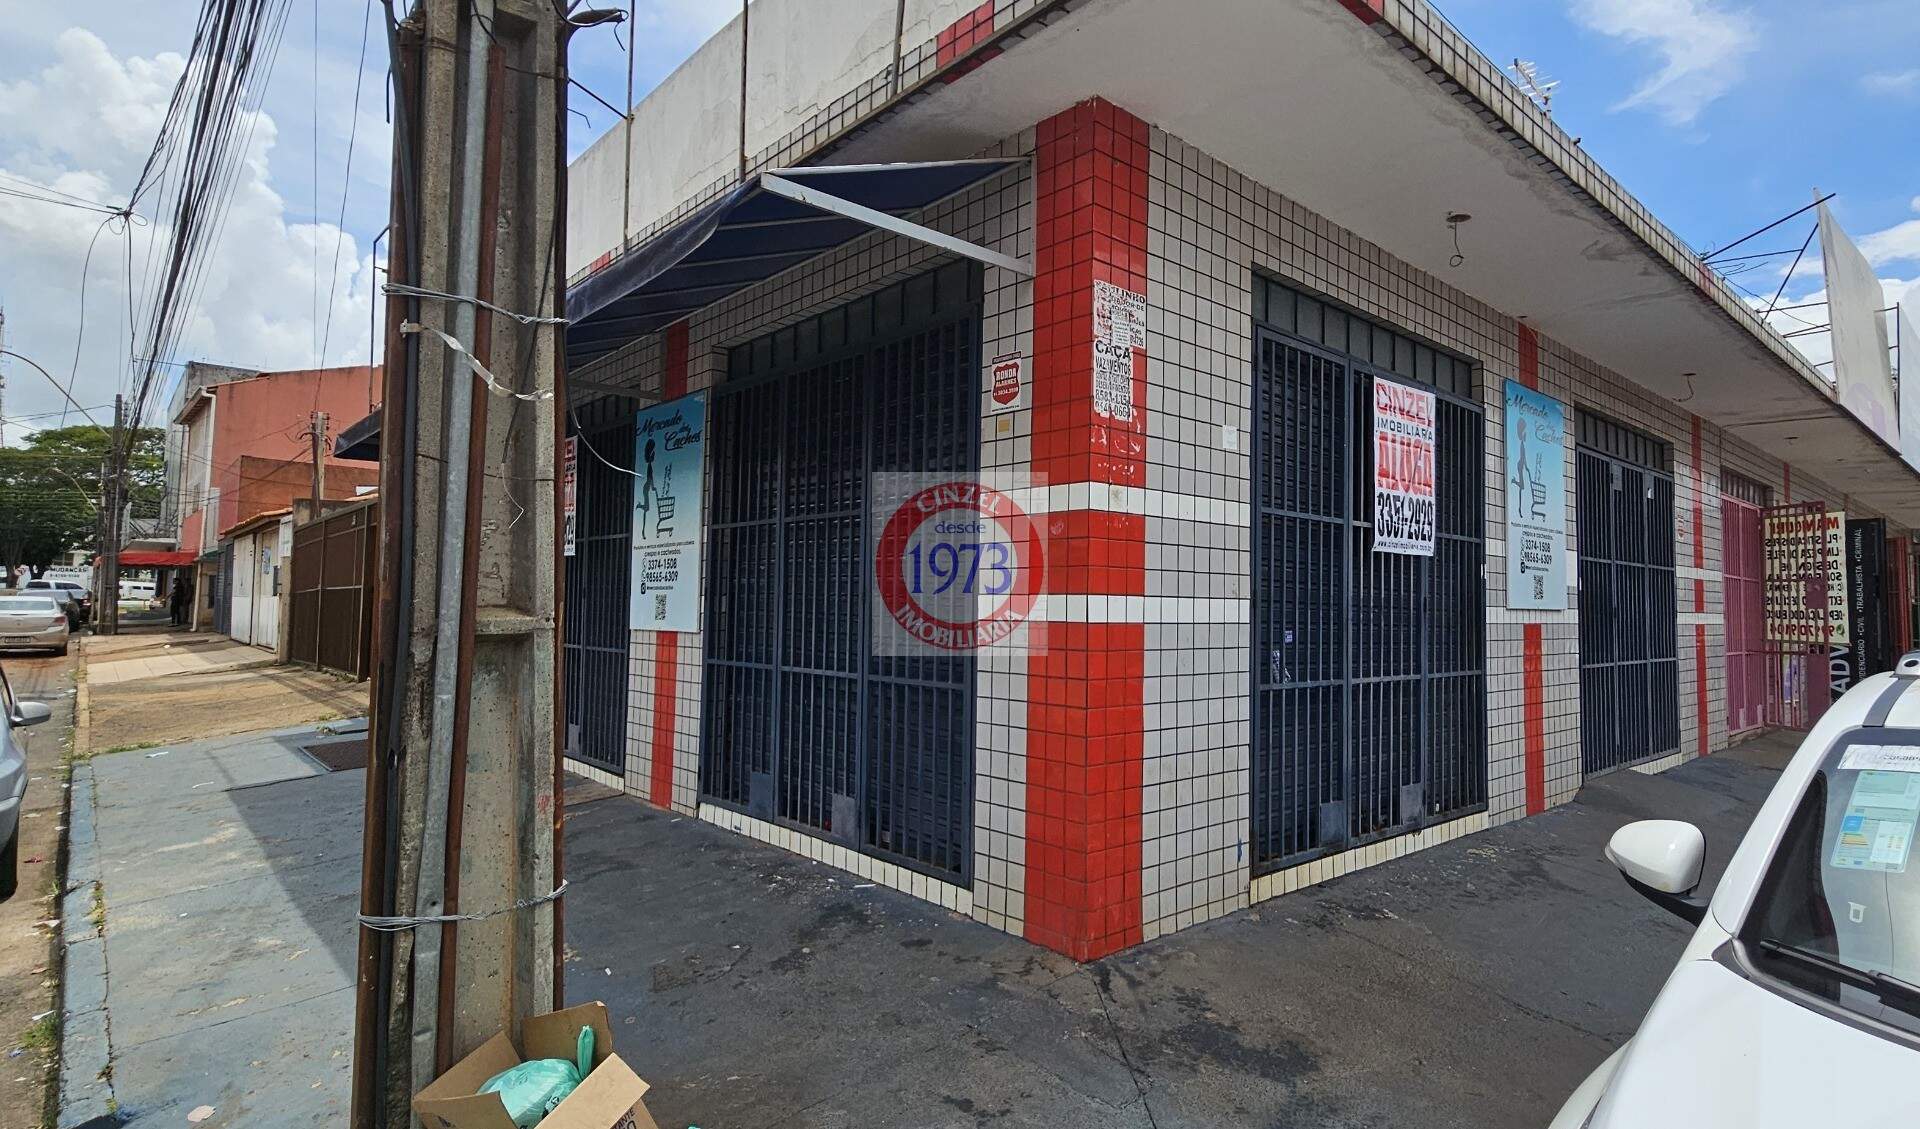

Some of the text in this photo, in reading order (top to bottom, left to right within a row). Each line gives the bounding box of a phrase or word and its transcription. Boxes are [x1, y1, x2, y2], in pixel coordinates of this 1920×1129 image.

[1377, 491, 1433, 543] 3351-2929
[1525, 539, 1551, 553] 3374-1508
[1854, 527, 1862, 559] CRIMINAL
[648, 558, 678, 571] 3374-1508
[1524, 551, 1552, 565] 98565-6309
[646, 570, 679, 583] 98565-6309
[1855, 564, 1864, 610] TRABALHISTA
